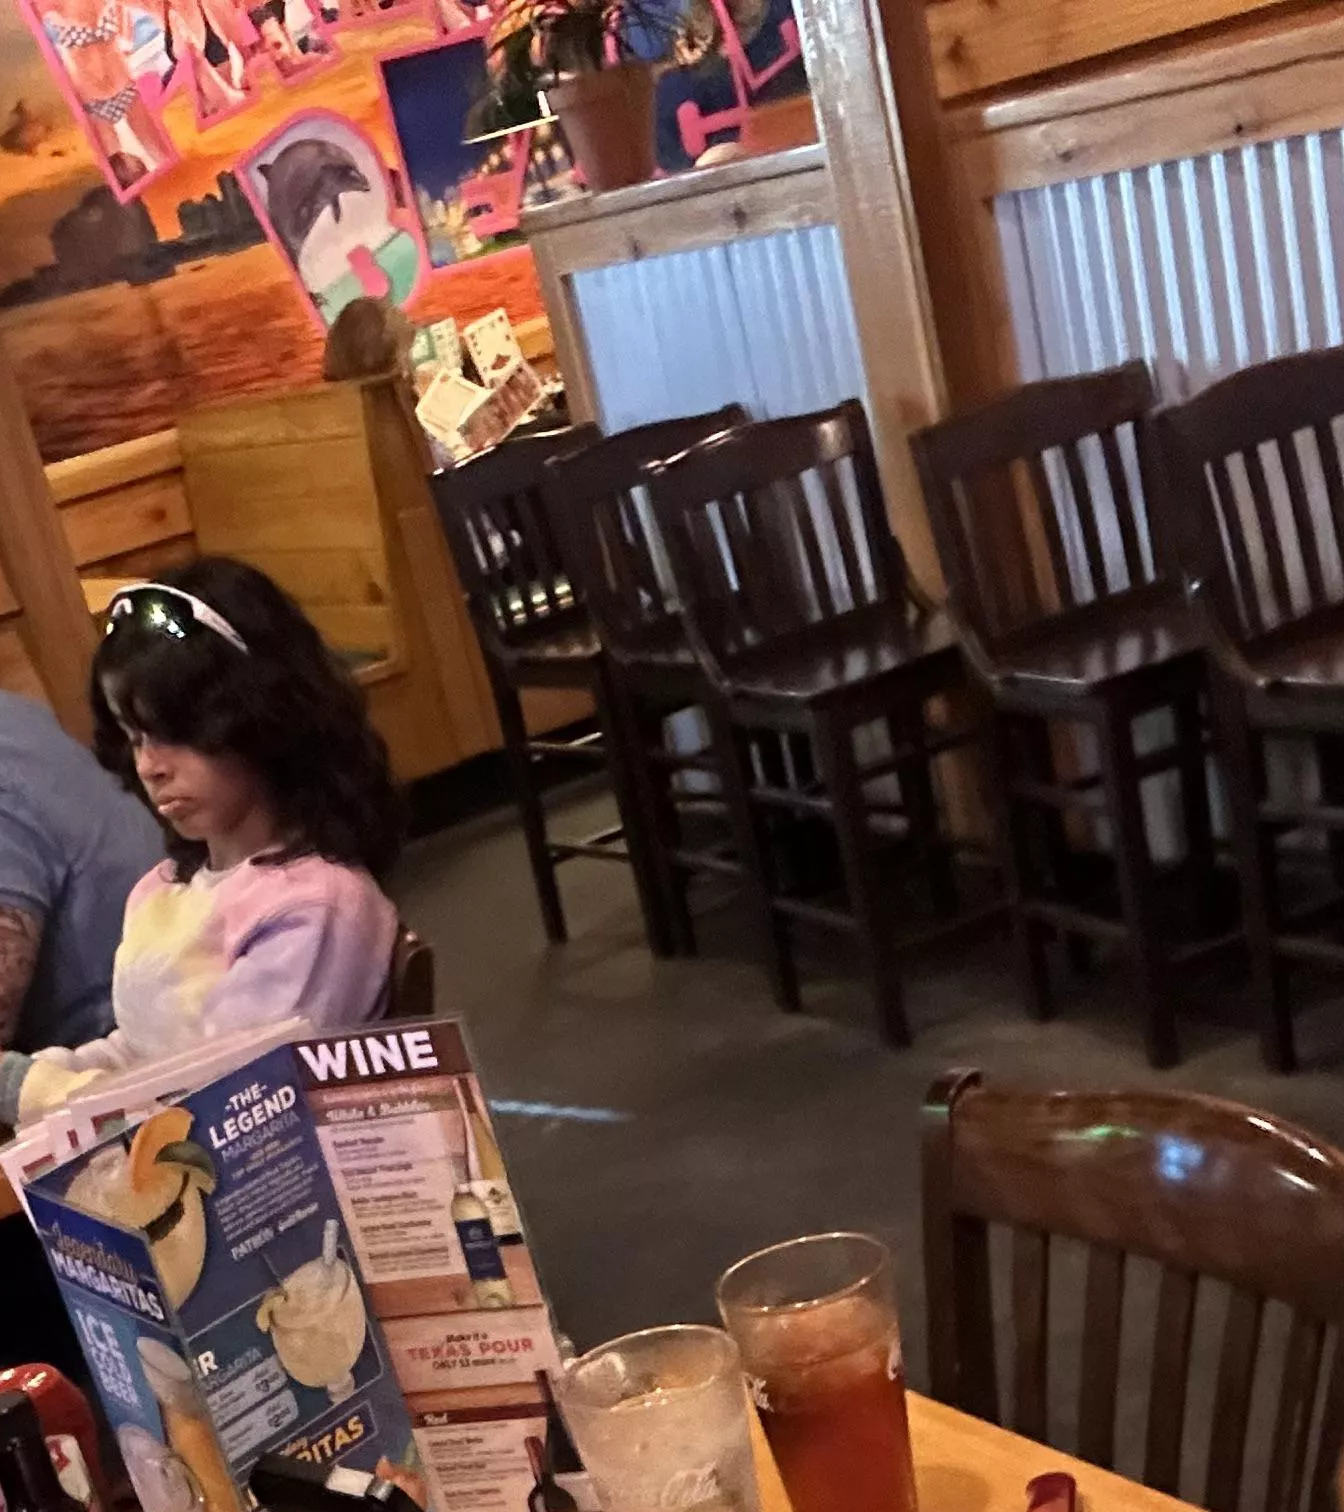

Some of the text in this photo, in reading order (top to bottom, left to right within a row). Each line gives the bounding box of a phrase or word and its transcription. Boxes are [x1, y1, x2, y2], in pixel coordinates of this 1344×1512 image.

[297, 1030, 439, 1081] WINE
[209, 1085, 296, 1149] LEGEND
[221, 1109, 301, 1163] MARGARITA
[51, 1248, 165, 1321] MARGARITAS
[408, 1337, 534, 1361] TEXAS POUR
